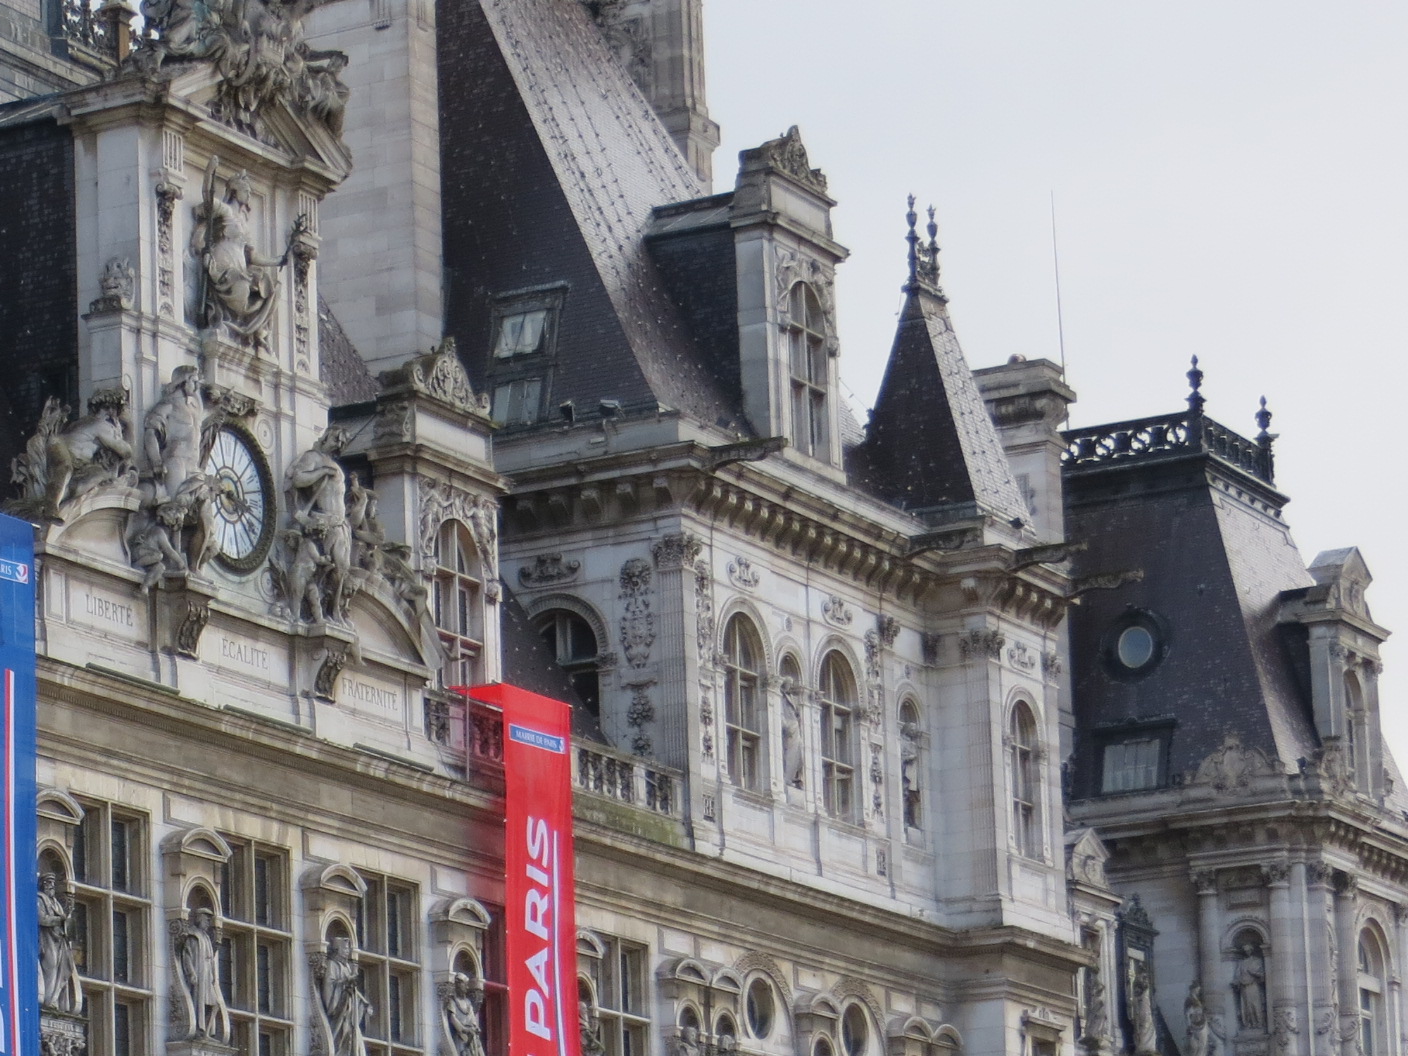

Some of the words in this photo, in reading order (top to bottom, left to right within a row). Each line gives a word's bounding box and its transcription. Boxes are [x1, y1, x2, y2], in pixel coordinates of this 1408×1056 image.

[85, 593, 133, 627] LIBERTÉ
[342, 677, 398, 711] FRATERNITÉ
[524, 815, 552, 1042] PARIS
